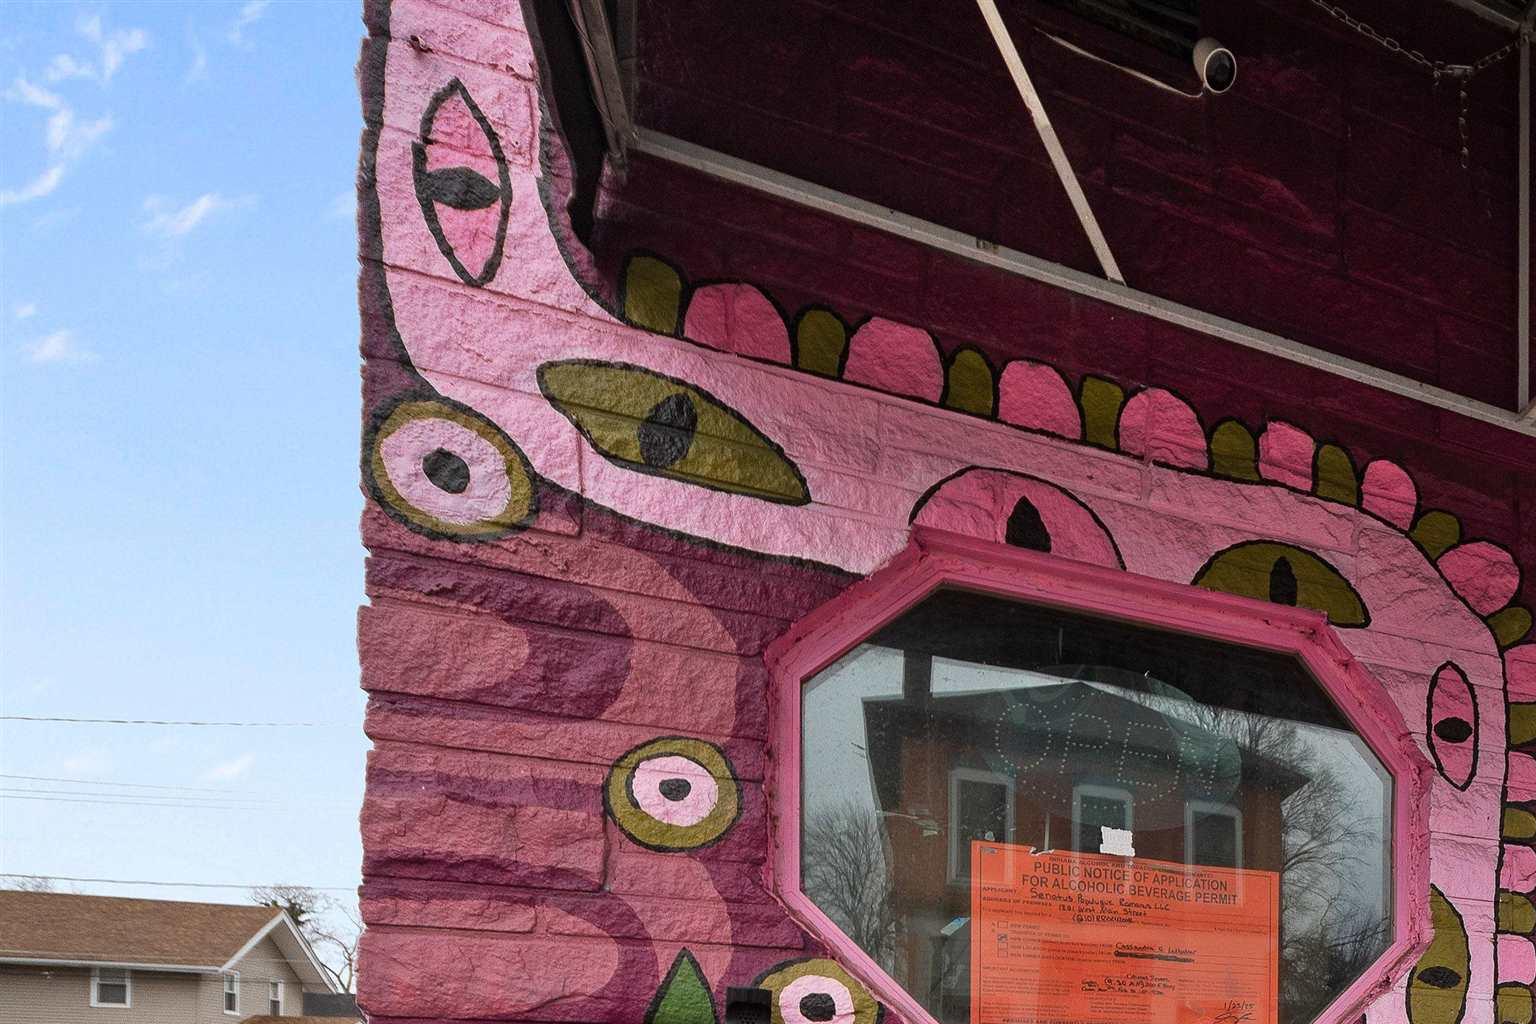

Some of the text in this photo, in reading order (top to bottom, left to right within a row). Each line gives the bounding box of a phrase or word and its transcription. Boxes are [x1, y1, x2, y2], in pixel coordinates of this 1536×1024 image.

[995, 703, 1221, 796] OPEN
[1021, 874, 1238, 905] FOR ALCOHOLIC BEVERAGE PERMIT
[1033, 861, 1081, 878] PUBLIC
[1083, 866, 1130, 881] NOTICE
[1133, 870, 1149, 883] OF
[1152, 872, 1228, 892] APPLICATION
